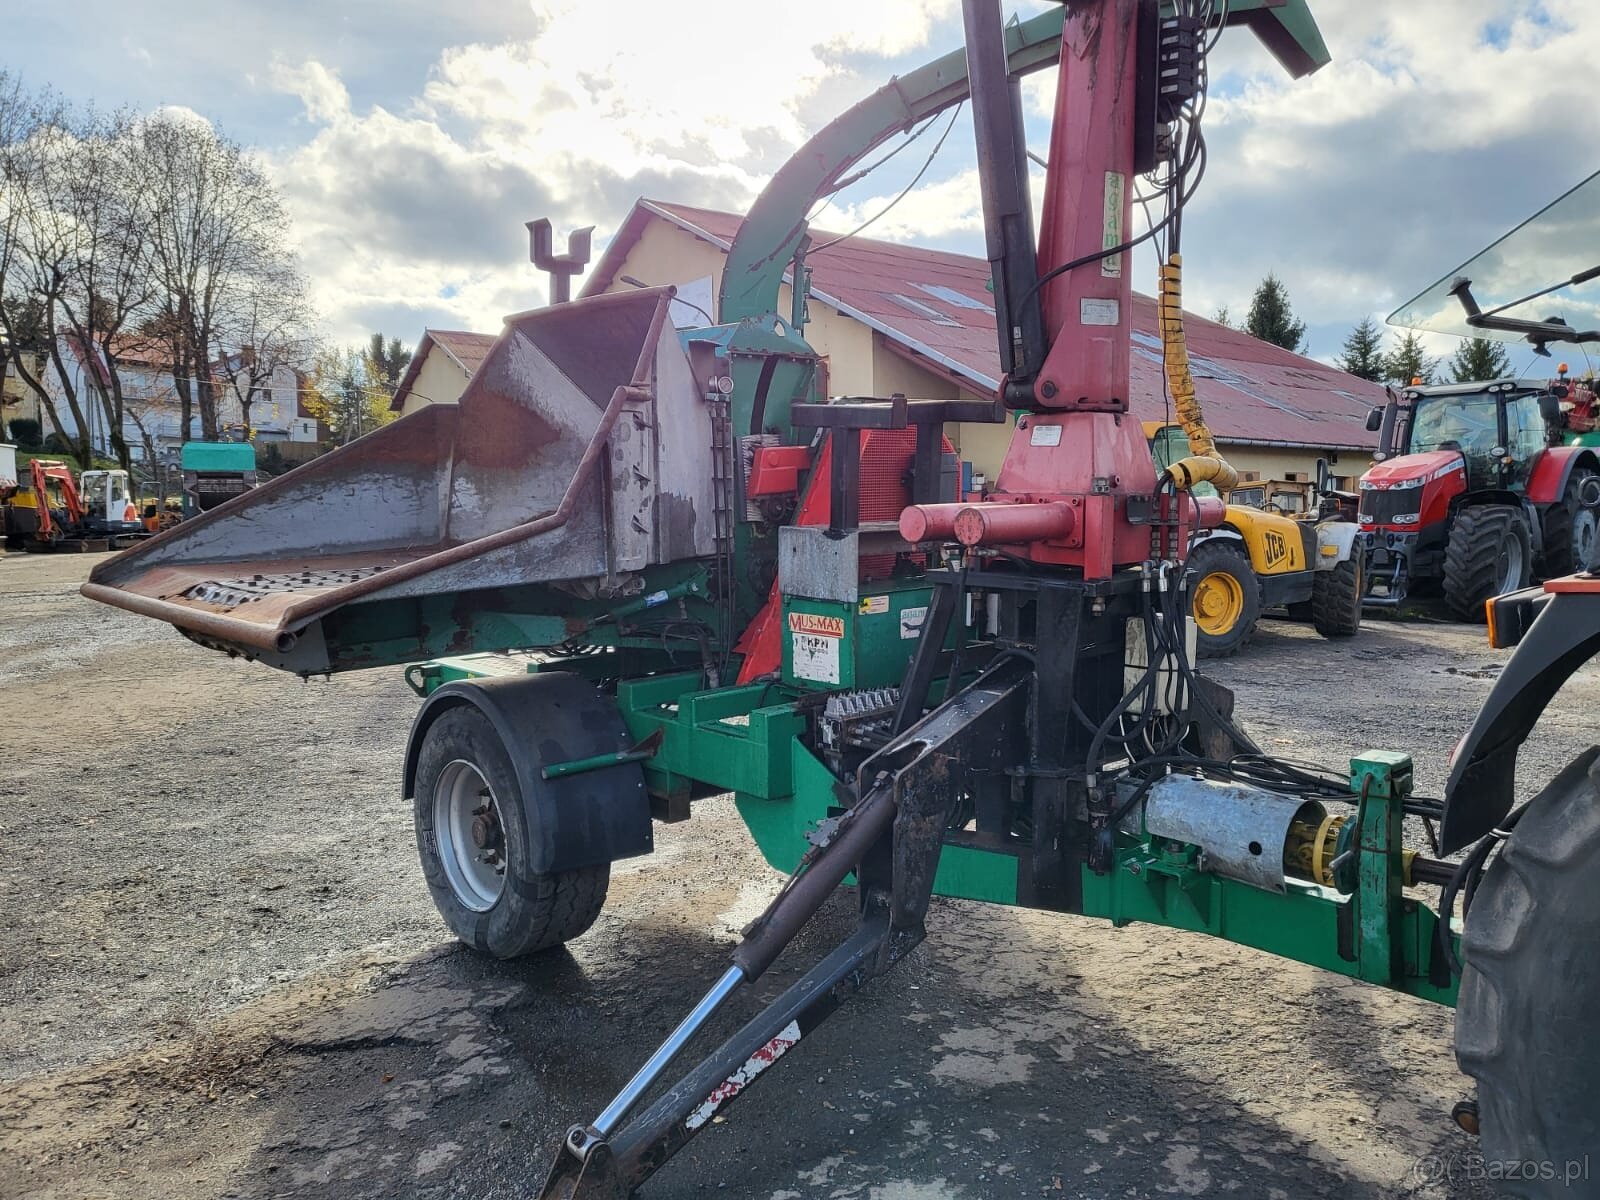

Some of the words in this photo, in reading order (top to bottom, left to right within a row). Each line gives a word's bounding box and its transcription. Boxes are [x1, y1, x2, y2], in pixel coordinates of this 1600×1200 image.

[1265, 531, 1285, 565] JCB
[789, 613, 842, 632] MUS-MAX
[902, 609, 925, 620] agam
